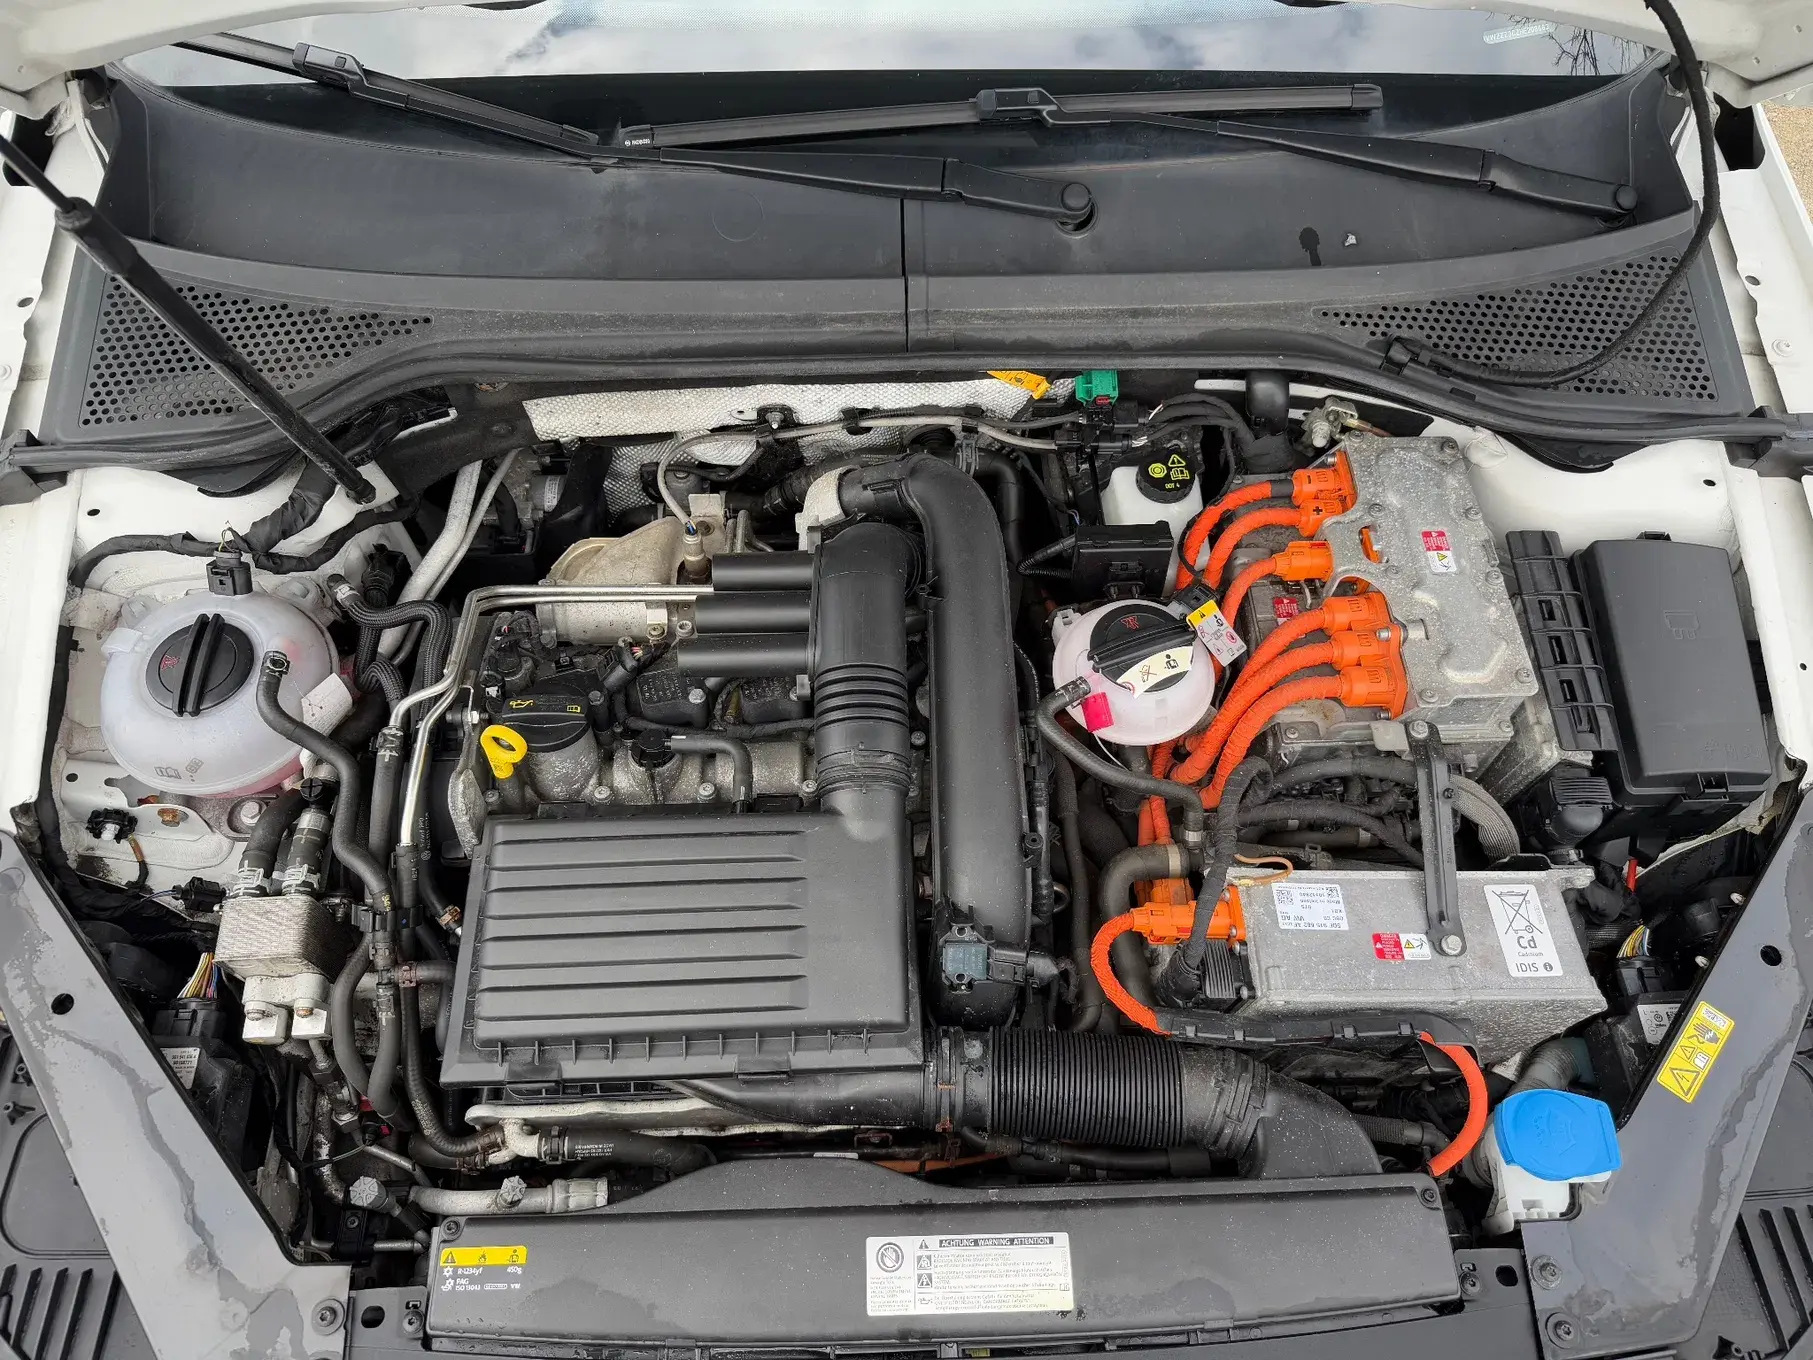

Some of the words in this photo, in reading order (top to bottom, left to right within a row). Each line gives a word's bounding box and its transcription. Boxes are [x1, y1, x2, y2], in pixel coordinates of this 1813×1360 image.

[1517, 935, 1537, 949] Cd
[1515, 962, 1539, 973] IDIS
[941, 1238, 975, 1248] ACHTUNG
[977, 1237, 1010, 1247] WARNING
[1013, 1237, 1050, 1246] ATTENTION
[457, 1266, 483, 1276] R-1234yf
[506, 1266, 522, 1275] 450g
